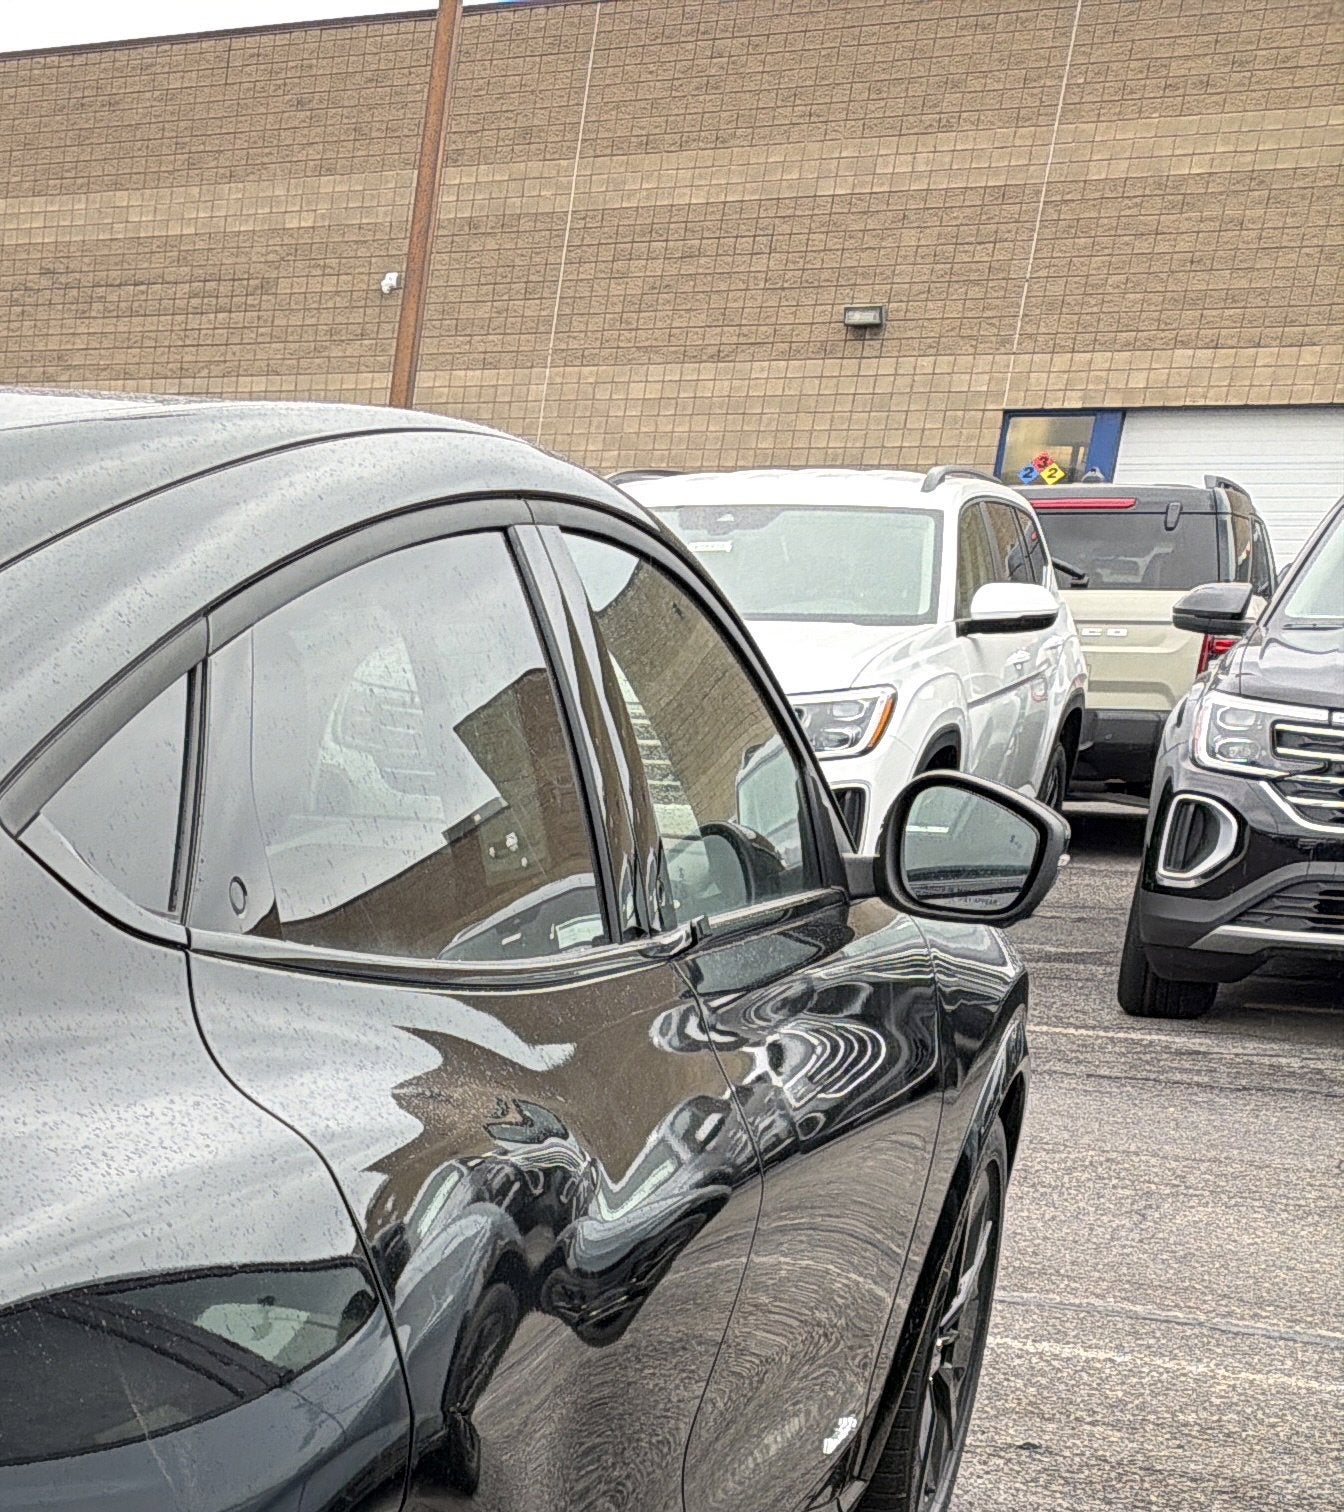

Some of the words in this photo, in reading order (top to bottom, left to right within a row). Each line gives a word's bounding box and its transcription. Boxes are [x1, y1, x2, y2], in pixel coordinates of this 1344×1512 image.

[1037, 455, 1049, 469] 3
[1022, 466, 1034, 478] 2
[1047, 467, 1058, 478] 2
